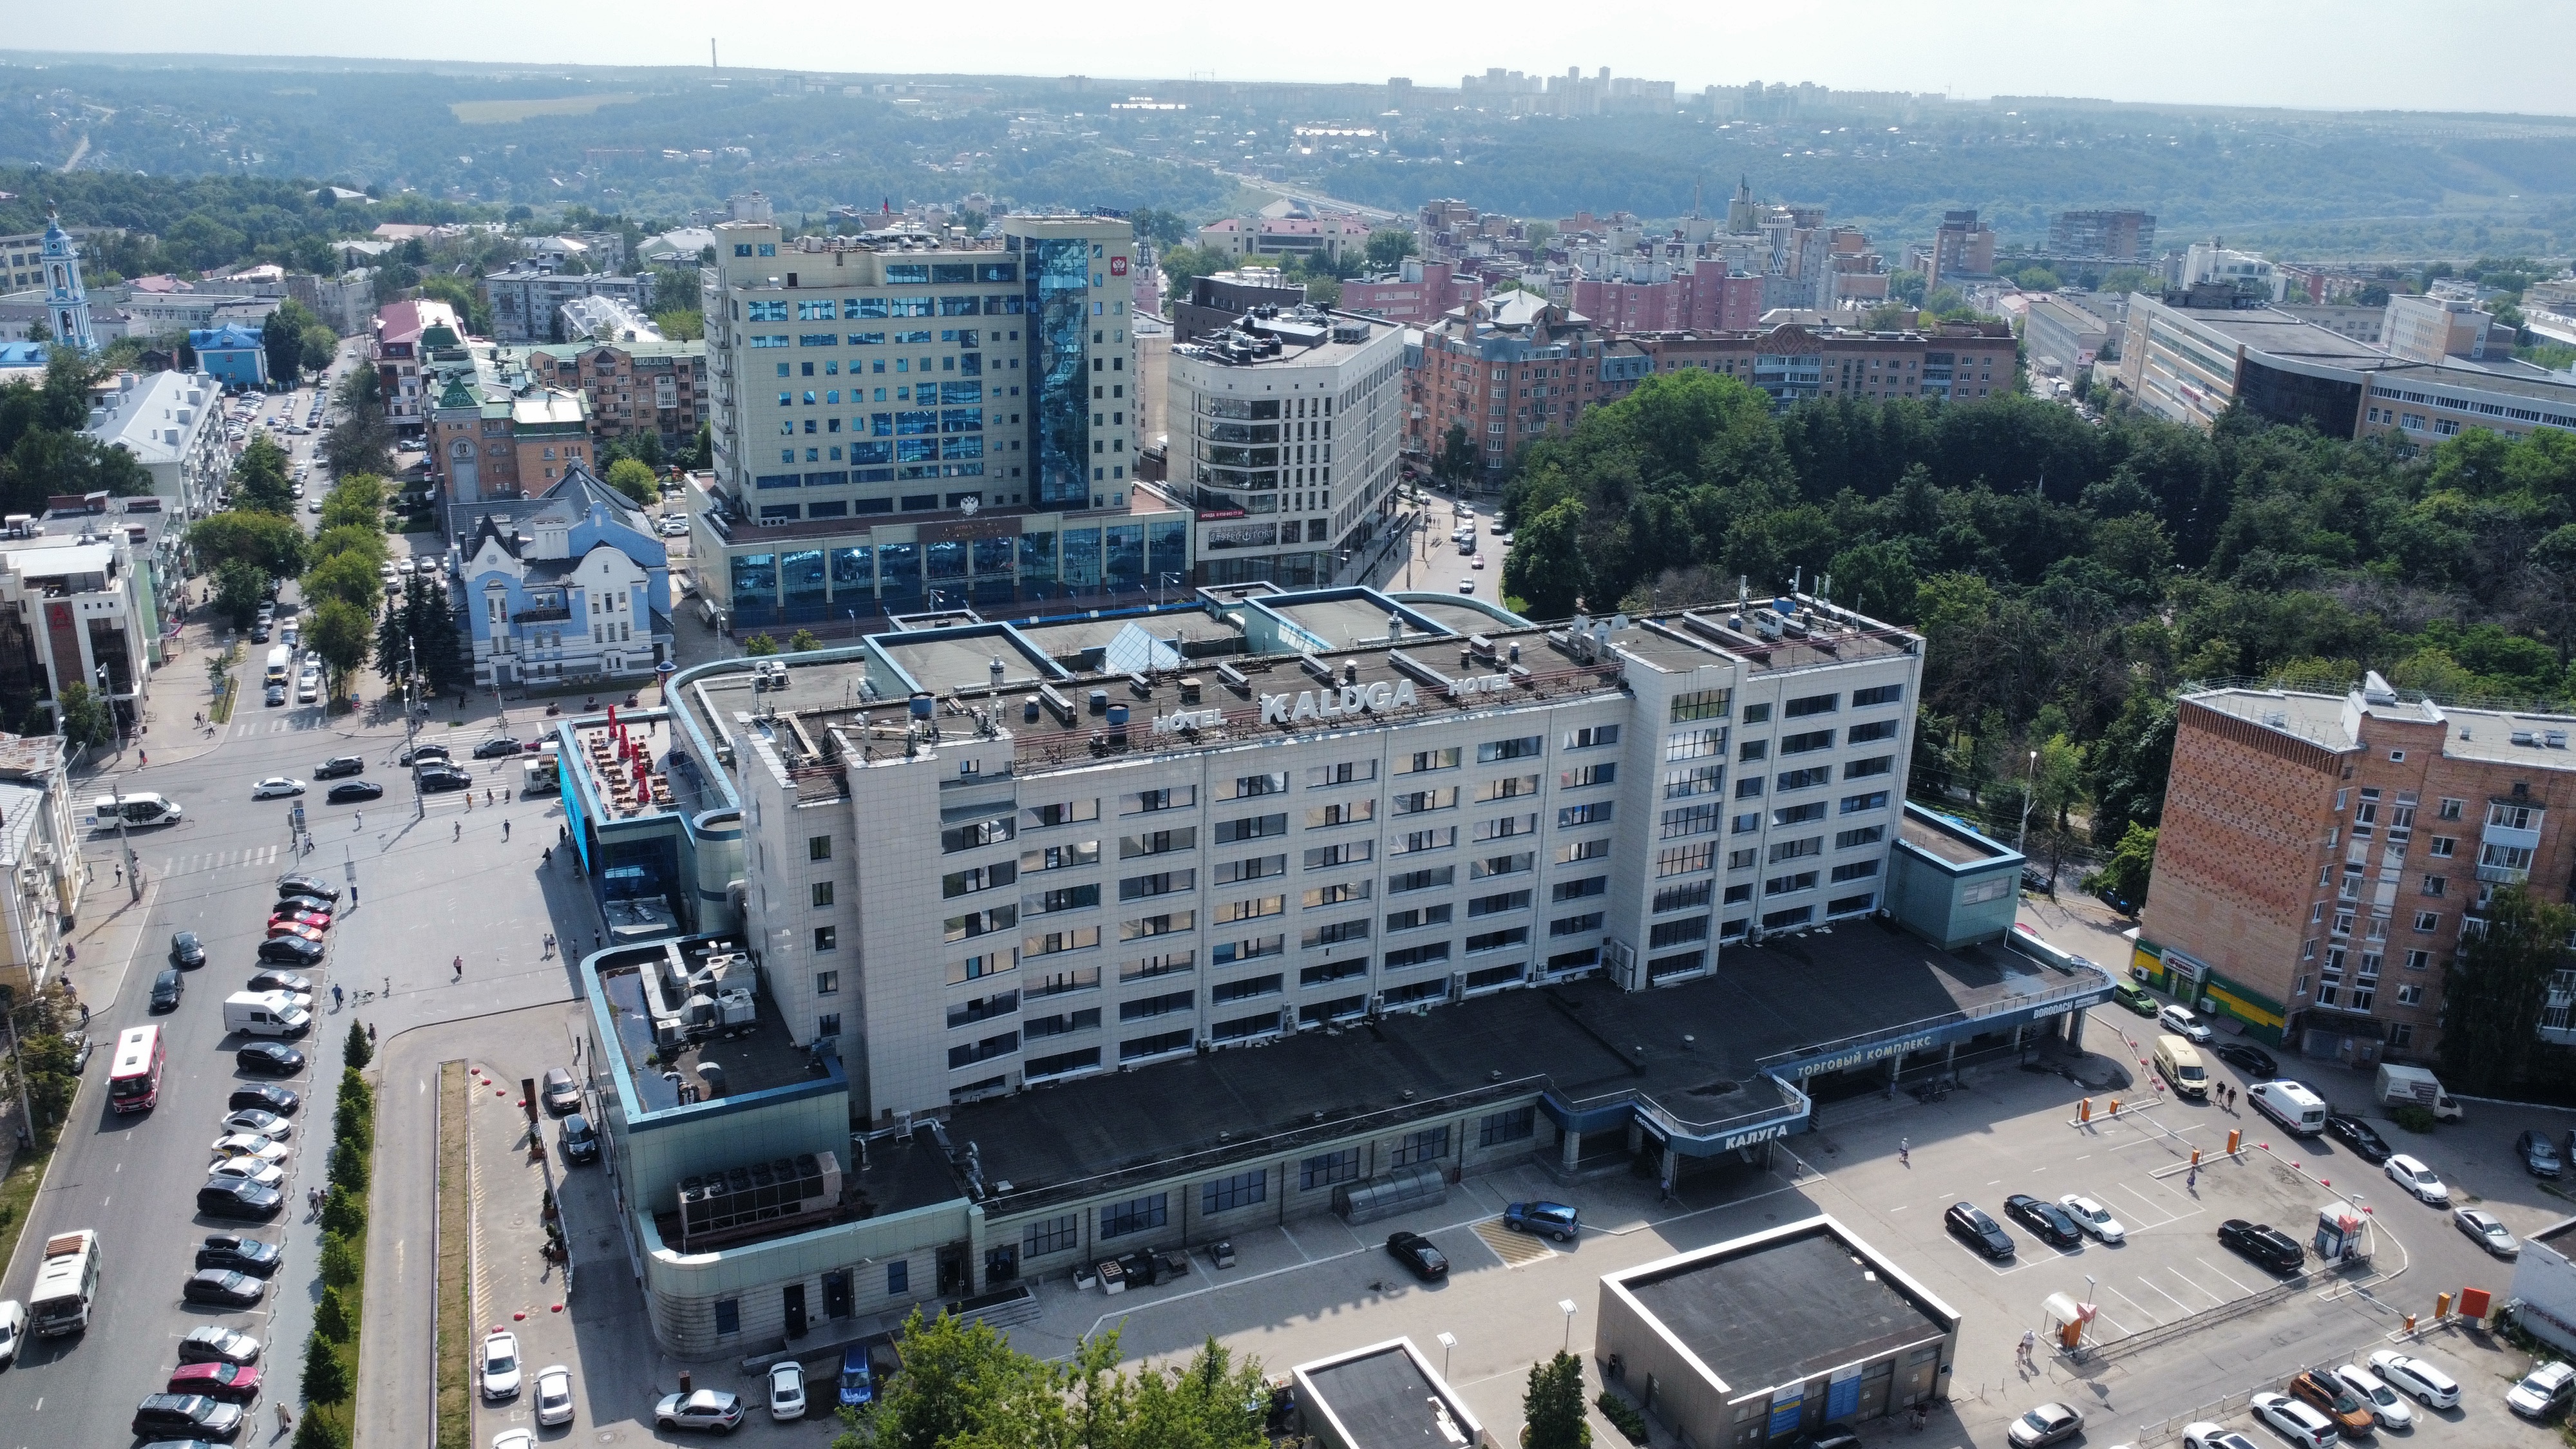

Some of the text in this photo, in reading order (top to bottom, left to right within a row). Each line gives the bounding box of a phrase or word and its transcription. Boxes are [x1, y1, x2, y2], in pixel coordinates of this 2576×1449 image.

[1448, 673, 1514, 696] HOTEL
[1261, 679, 1417, 724] KALUGA
[1153, 708, 1227, 735] HOTEL
[2033, 1001, 2073, 1019] BORODACH
[1797, 1036, 1931, 1077] ТОРГОВЫЙ КОМПЛЕКС
[1634, 1114, 1665, 1142] ГОСТИНИЦА
[1725, 1124, 1788, 1150] КАЛУГА
